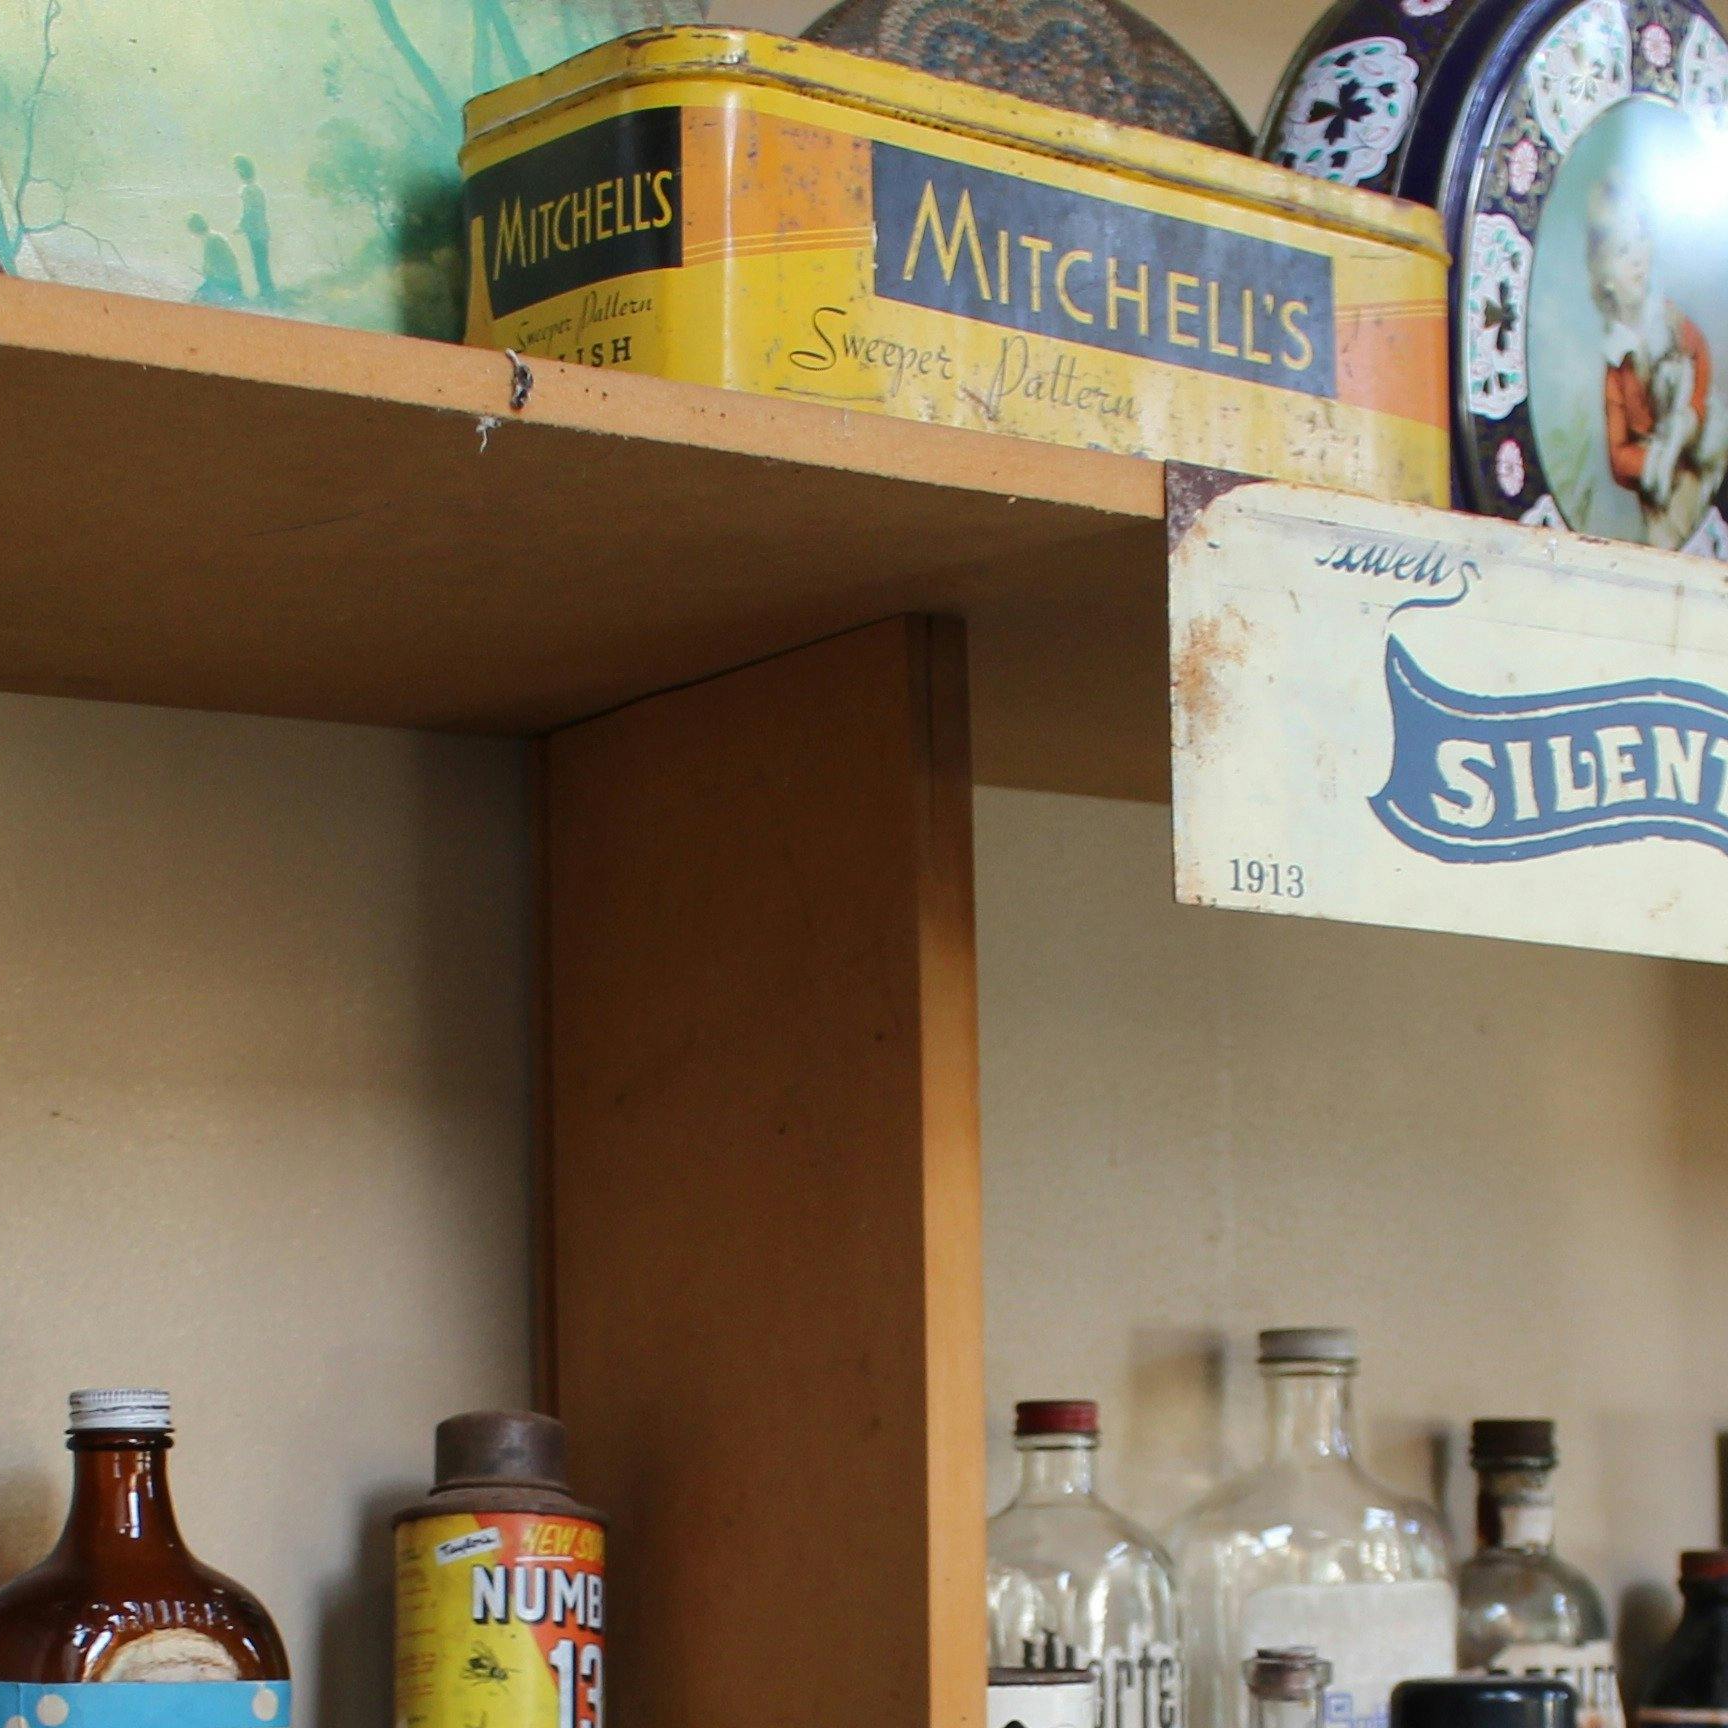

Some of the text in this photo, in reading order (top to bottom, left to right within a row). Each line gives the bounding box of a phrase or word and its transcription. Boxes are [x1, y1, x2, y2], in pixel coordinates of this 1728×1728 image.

[491, 168, 674, 284] MITCHELL'S
[900, 179, 1315, 371] MITCHELL'S
[790, 306, 1142, 421] Sweeper Pattern
[1228, 857, 1306, 900] 1913
